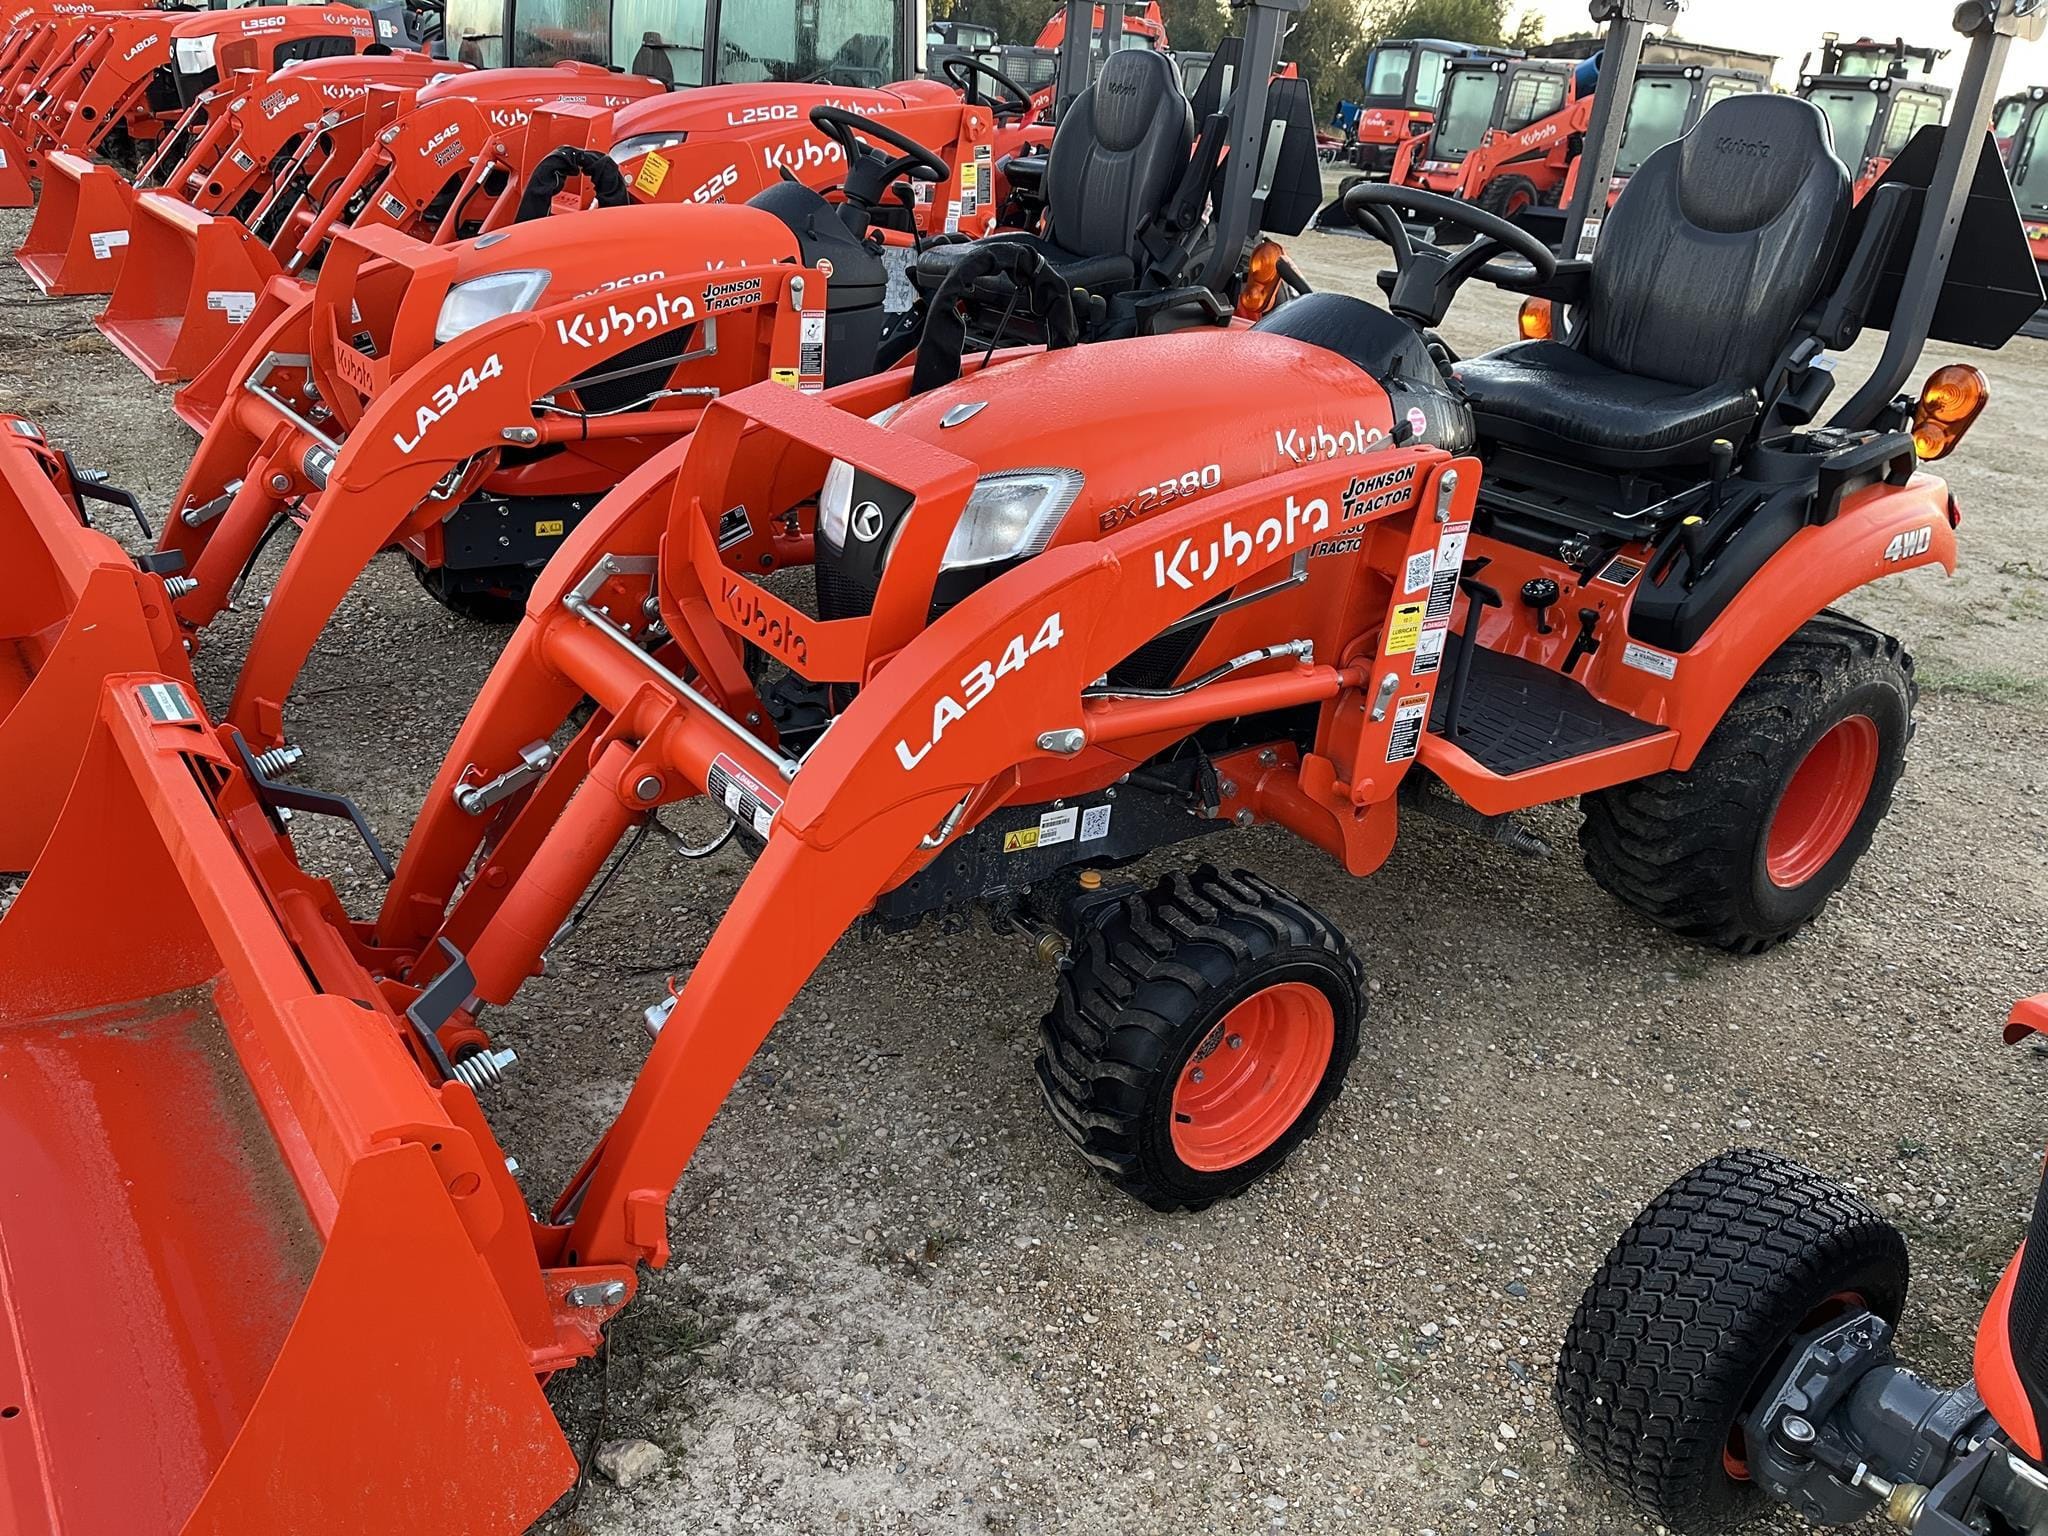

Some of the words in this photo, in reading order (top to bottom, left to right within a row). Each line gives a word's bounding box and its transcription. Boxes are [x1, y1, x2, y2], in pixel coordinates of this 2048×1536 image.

[53, 4, 94, 14] Kubota
[241, 16, 285, 30] L3560
[323, 13, 370, 26] Kubota
[123, 34, 158, 61] LA805
[323, 84, 369, 98] Kubo
[266, 94, 299, 119] LA545
[491, 108, 531, 126] Kub
[727, 105, 798, 126] L2502
[419, 123, 460, 157] LA545
[1520, 124, 1557, 146] Kubota
[764, 136, 868, 171] Kubo
[702, 278, 762, 300] JOHNSON
[704, 291, 762, 313] TRACTOR
[556, 293, 695, 348] Kubota
[392, 353, 503, 454] LA344
[1275, 420, 1384, 463] Kubota
[1097, 463, 1222, 531] BX2380
[1342, 465, 1417, 500] JOHNSON
[1342, 487, 1413, 520] TRACTOR
[1154, 496, 1329, 590] Kubota
[1884, 525, 1932, 562] 4WD
[721, 576, 807, 667] Kubota
[1392, 626, 1418, 636] LUBRICATE
[894, 611, 1065, 772] LA344
